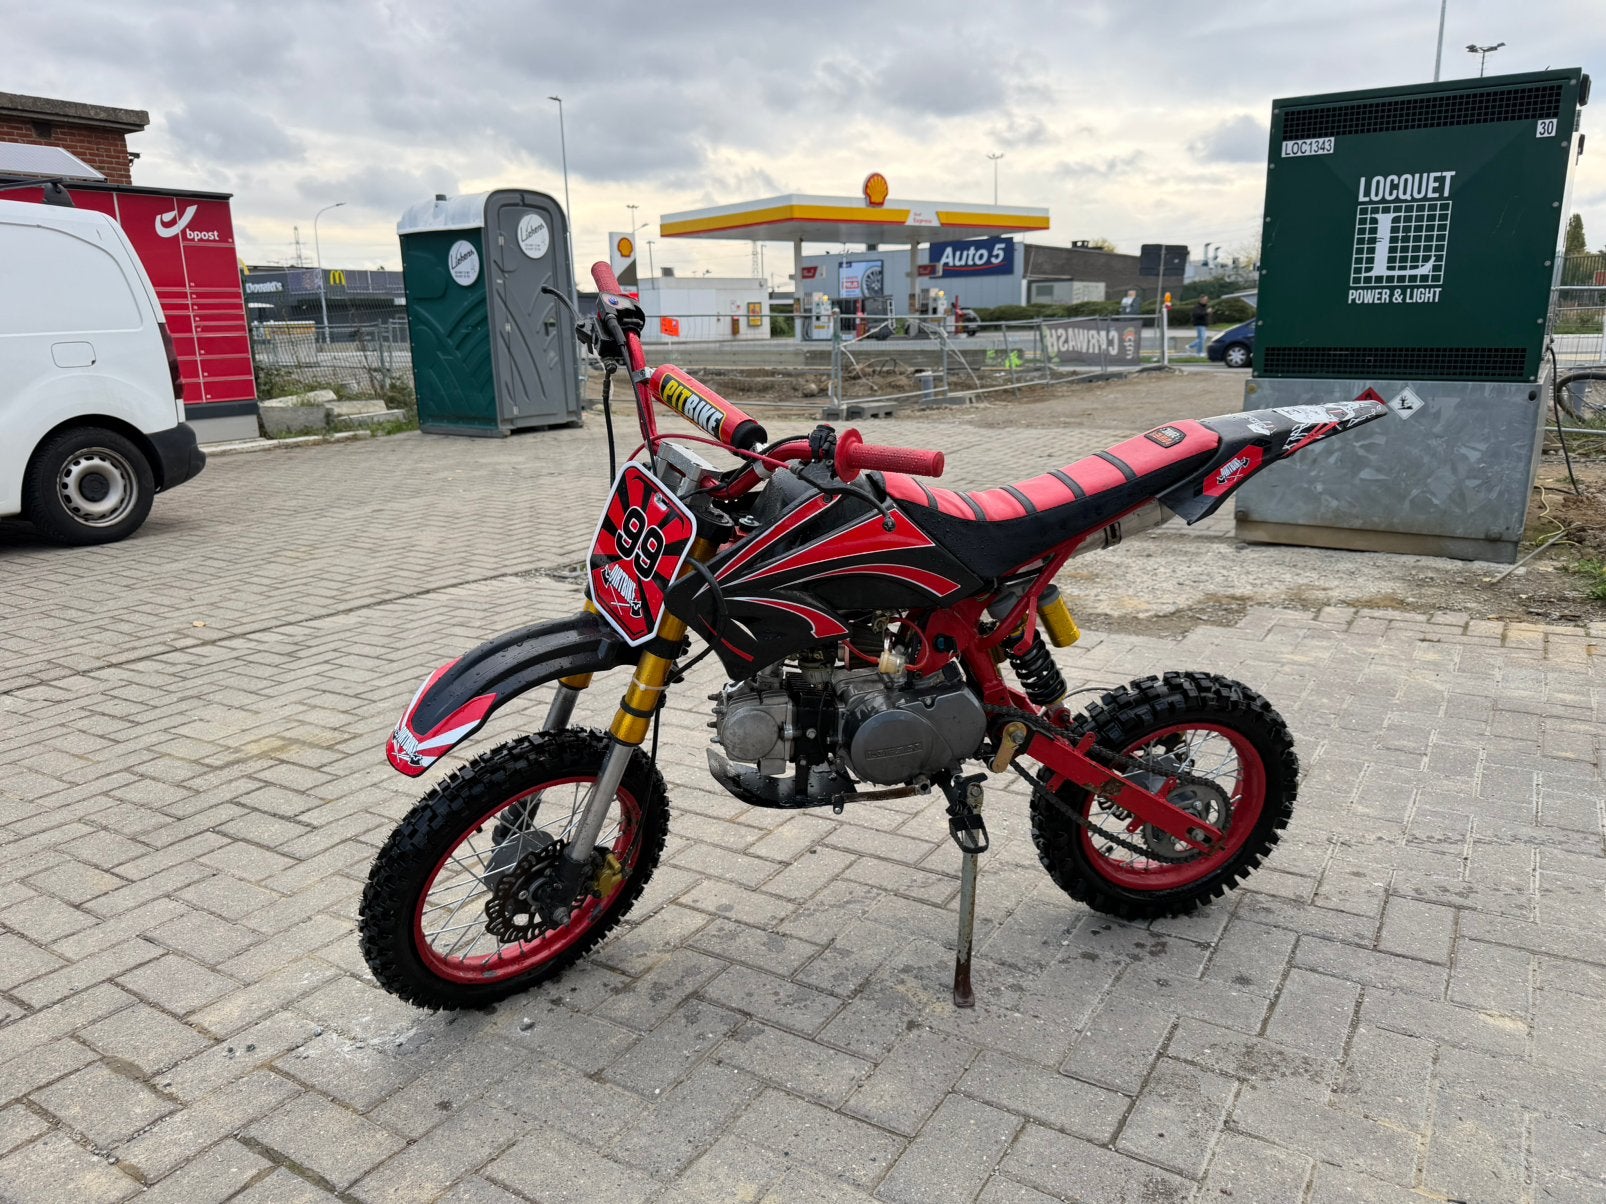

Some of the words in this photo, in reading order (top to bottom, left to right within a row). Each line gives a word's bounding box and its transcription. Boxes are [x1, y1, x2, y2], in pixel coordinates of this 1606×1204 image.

[1539, 120, 1554, 136] 30
[1284, 138, 1333, 156] LOC1343
[1358, 171, 1456, 202] LOCQUET
[186, 228, 220, 242] bpost
[940, 246, 989, 267] Auto
[990, 243, 1006, 264] 5
[1348, 289, 1391, 304] POWER
[1392, 288, 1404, 303] &
[1405, 287, 1442, 303] LIGHT
[615, 506, 666, 581] 99
